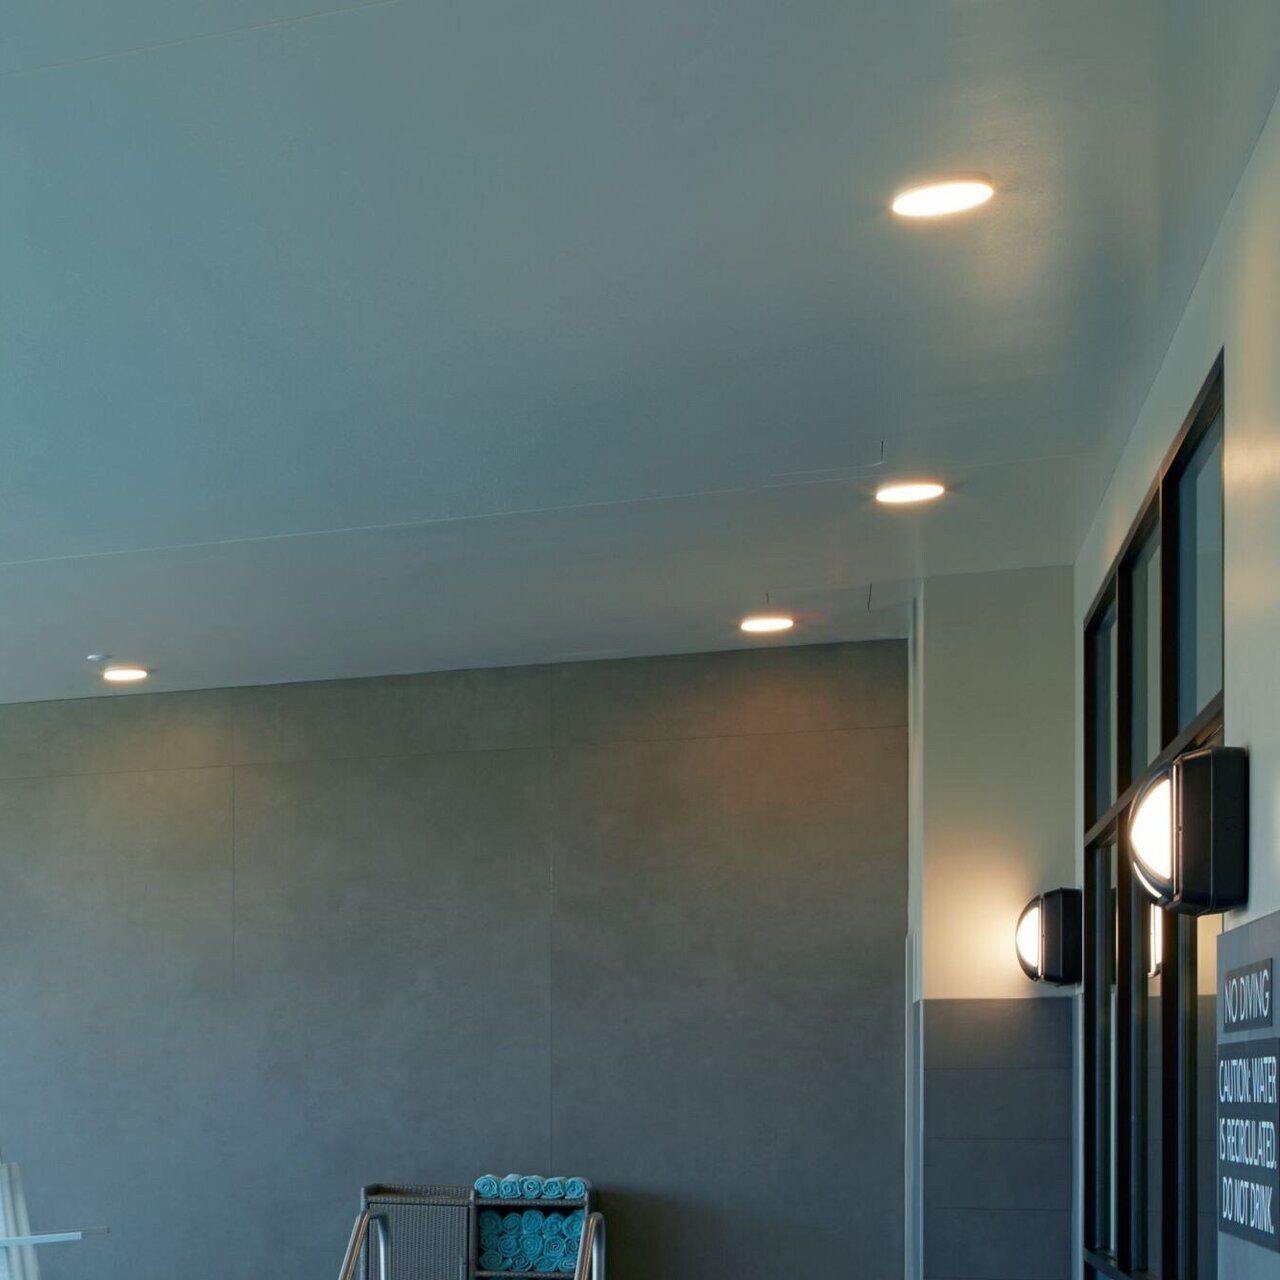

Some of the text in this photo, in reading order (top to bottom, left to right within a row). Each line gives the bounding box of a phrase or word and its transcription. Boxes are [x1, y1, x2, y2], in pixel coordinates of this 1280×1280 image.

[1224, 969, 1270, 1023] NO DIVING
[1219, 1056, 1277, 1103] CAUTION: WATER
[1219, 1118, 1277, 1169] IS RECIRCULATED.
[1222, 1176, 1275, 1234] DO NOT DRINK.
